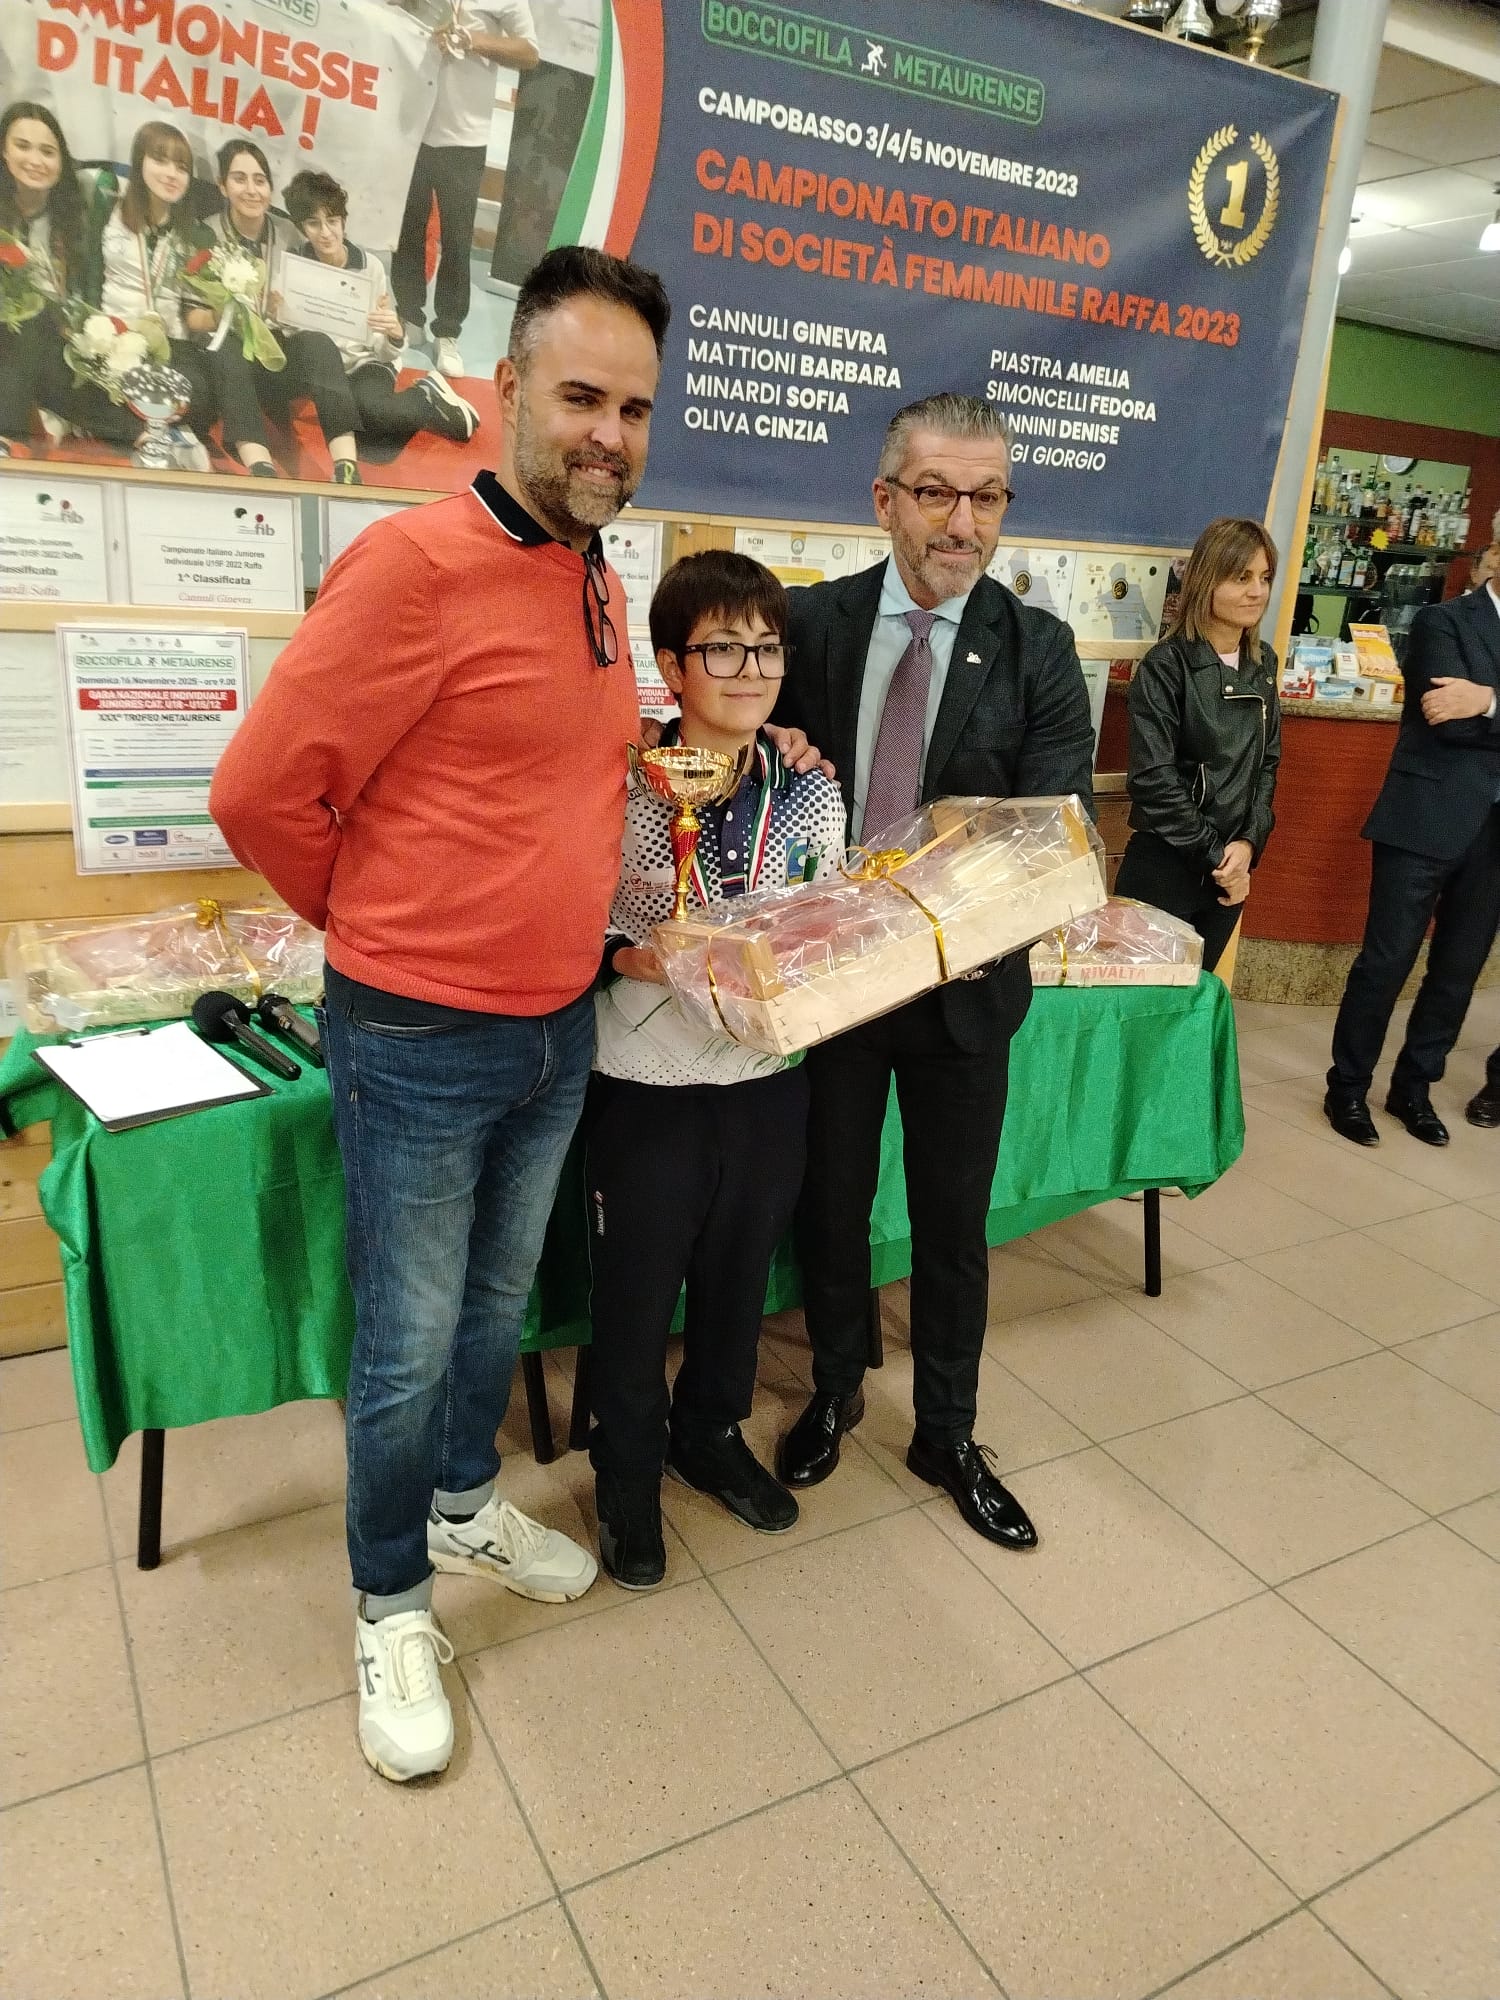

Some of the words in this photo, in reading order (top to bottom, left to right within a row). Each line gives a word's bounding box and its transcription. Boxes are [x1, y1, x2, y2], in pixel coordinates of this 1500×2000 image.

[706, 0, 853, 67] BOCCIOFILA
[893, 50, 1041, 117] METAURENSE
[698, 86, 863, 147] CAMPOBASSO
[865, 122, 923, 164] 3/4/5
[924, 140, 1034, 188] NOVEMBRE
[1033, 166, 1079, 198] 2023
[695, 149, 957, 237] CAMPIONATO
[961, 206, 1111, 268] ITALIANO
[1219, 160, 1249, 229] 1
[693, 213, 734, 257] DI
[741, 223, 898, 285] SOCIETÀ
[905, 254, 1079, 318] FEMMINILE
[1081, 287, 1171, 336] RAFFA
[1174, 304, 1241, 347] 2023
[689, 303, 789, 341] CANNULI
[792, 320, 888, 356] GINEVRA
[687, 338, 796, 377] MATTIONI
[799, 354, 902, 389] BARBARA
[990, 349, 1063, 381] PIASTRA
[1065, 361, 1130, 390] AMELIA
[686, 372, 781, 407] MINARDI
[785, 385, 850, 415] SOFIA
[985, 379, 1088, 413] SIMONCELLI
[1089, 394, 1157, 422] FEDORA
[684, 406, 750, 437] OLIVA
[754, 414, 829, 444] CINZIA
[1058, 419, 1121, 445] DENISE
[1010, 443, 1030, 464] GI
[1032, 445, 1107, 473] GIORGIO
[160, 544, 206, 555] Campionato
[206, 547, 233, 557] Italiano
[234, 549, 265, 558] Juniores
[192, 574, 251, 585] Classificata
[76, 655, 143, 667] BOCCIOFILA
[160, 656, 233, 668] METAURENSE
[160, 713, 221, 722] METAURENSE
[1080, 965, 1146, 980] RIVALTA
